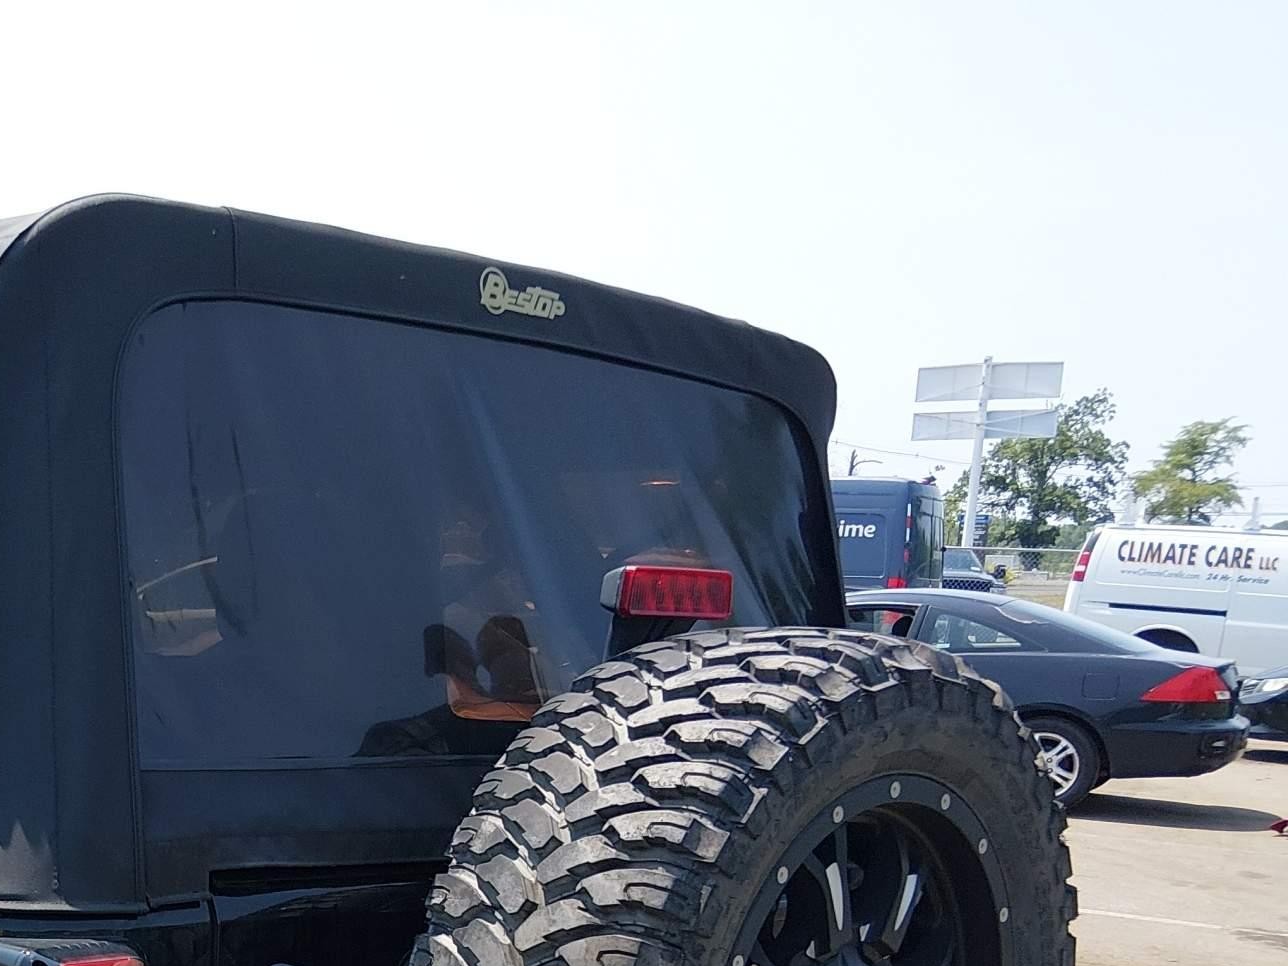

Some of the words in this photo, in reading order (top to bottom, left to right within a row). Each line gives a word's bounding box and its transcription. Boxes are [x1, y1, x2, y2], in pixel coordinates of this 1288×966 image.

[838, 519, 877, 538] ime
[1117, 540, 1199, 566] CLIMATE
[1205, 545, 1255, 569] CARE
[1258, 556, 1280, 571] LLC
[1235, 575, 1270, 585] Service
